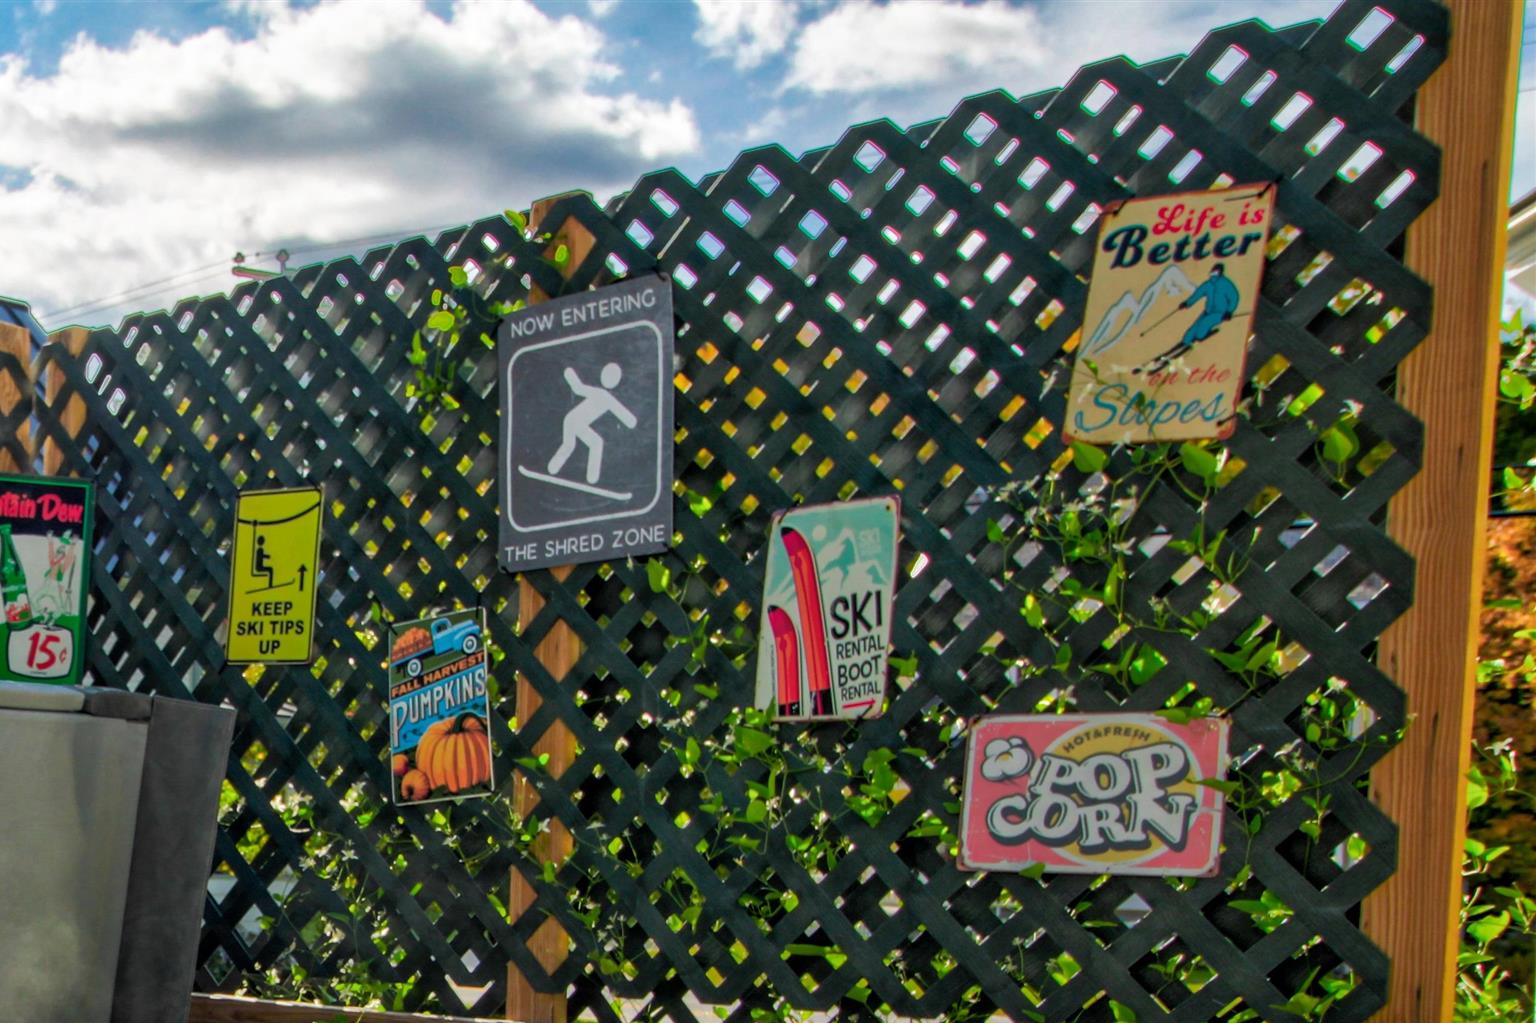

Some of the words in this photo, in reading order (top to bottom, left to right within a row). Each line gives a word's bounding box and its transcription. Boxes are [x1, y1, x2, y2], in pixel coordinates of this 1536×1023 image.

[1152, 203, 1226, 236] Life
[1239, 203, 1265, 228] is
[1102, 223, 1263, 270] Better
[510, 313, 554, 338] NOW
[561, 288, 656, 327] ENTERING
[1188, 364, 1232, 385] the
[1074, 383, 1228, 436] Slopes
[505, 542, 537, 563] THE
[545, 533, 604, 557] SHRED
[612, 525, 665, 548] ZONE
[251, 601, 293, 616] KEEP
[830, 590, 882, 640] SKI
[236, 621, 263, 636] SKI
[269, 620, 304, 635] TIPS
[258, 640, 281, 655] UP
[836, 635, 885, 660] RENTAL
[391, 677, 420, 698] FALL
[424, 652, 484, 685] HARVEST
[838, 655, 882, 687] BOOT
[392, 669, 487, 748] PUMPKINS
[841, 681, 881, 701] RENTAL
[1029, 742, 1191, 800] POP
[986, 793, 1196, 852] CORN
